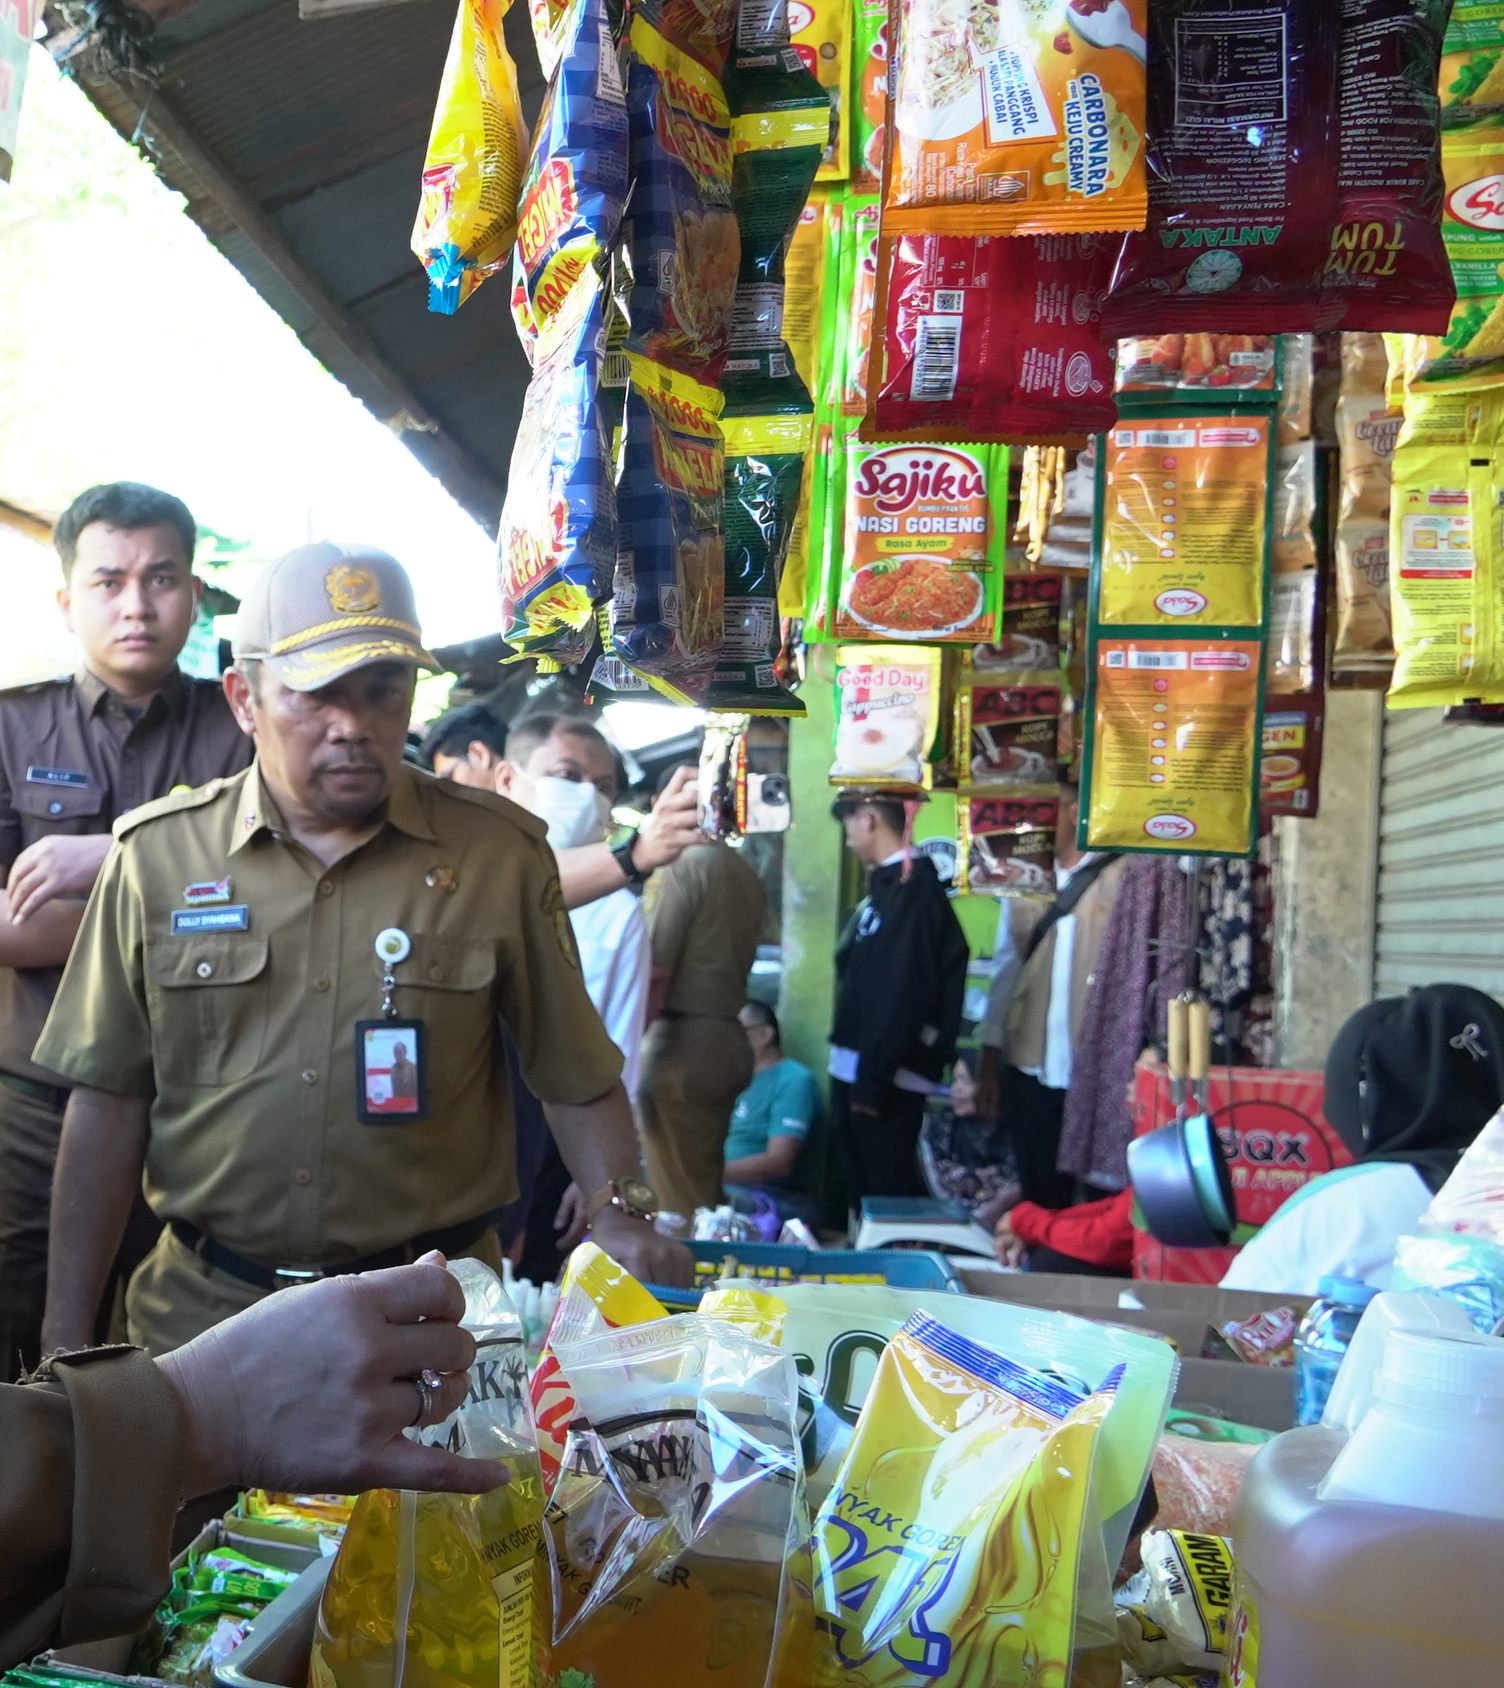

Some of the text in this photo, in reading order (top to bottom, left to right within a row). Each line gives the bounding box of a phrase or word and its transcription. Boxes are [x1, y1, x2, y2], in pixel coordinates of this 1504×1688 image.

[994, 93, 1008, 124] CABAI
[1004, 79, 1026, 136] PANGGANG
[1019, 88, 1040, 124] KRISPI
[1066, 101, 1083, 135] KEJU
[1080, 74, 1108, 196] CARBONARA
[1068, 136, 1084, 191] CREAMY
[925, 184, 934, 198] 80
[1159, 225, 1283, 249] ANTAKA
[1330, 223, 1405, 250] TUM
[1323, 250, 1397, 275] TUM
[855, 458, 987, 514] Sajiku
[854, 515, 986, 534] NASI GORENG
[886, 539, 947, 551] Rasa Ayam
[837, 668, 925, 690] Good Day
[840, 691, 915, 715] Cappuccino
[974, 689, 1058, 716] ABC
[973, 801, 1057, 828] ABC
[1183, 1533, 1231, 1608] GARAM
